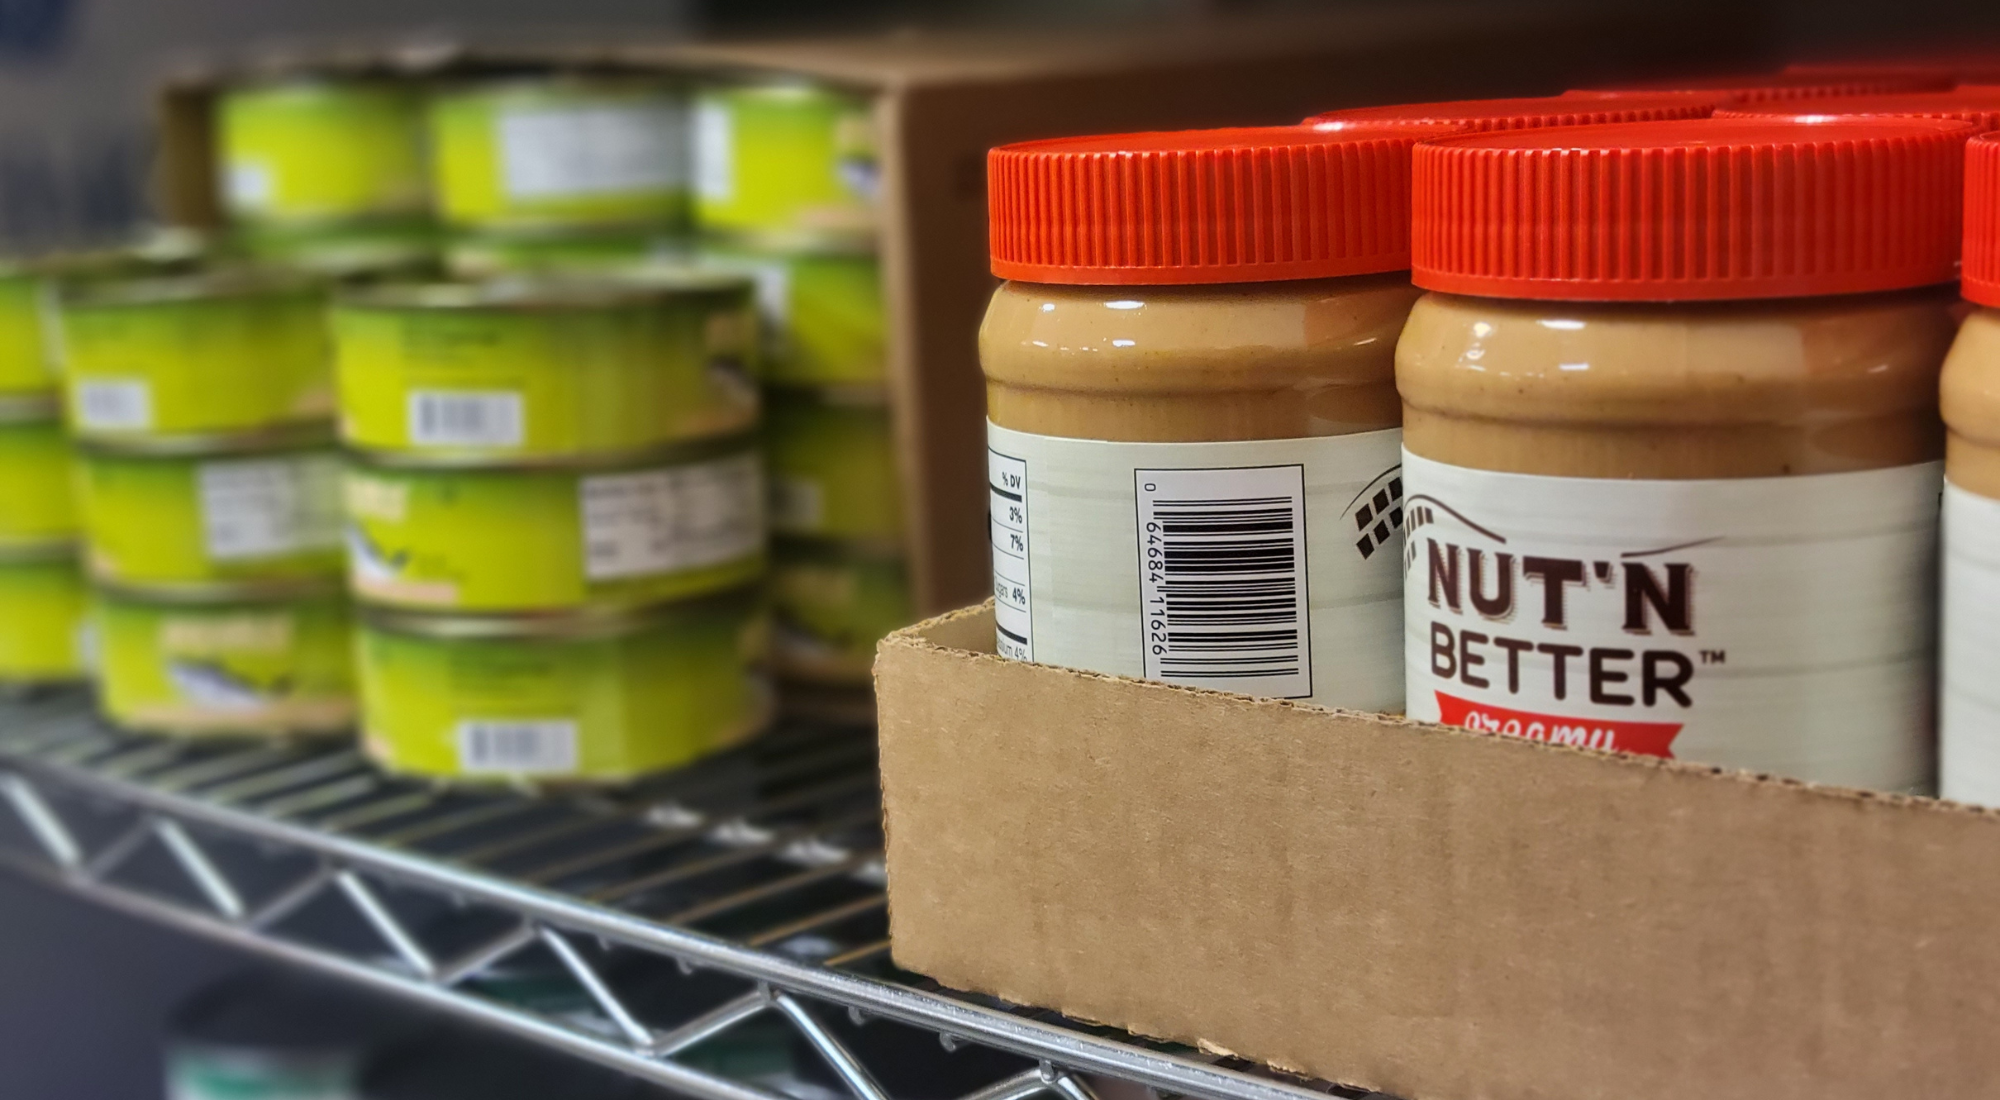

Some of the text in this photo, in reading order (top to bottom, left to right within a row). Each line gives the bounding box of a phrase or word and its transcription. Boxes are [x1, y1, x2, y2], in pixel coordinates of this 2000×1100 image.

[1002, 471, 1021, 489] % DV
[1009, 506, 1023, 524] 3%
[1010, 534, 1024, 552] 7%
[1144, 483, 1167, 655] 0 64684 11626
[1427, 537, 1696, 636] NUT'N
[1012, 587, 1026, 606] 4%
